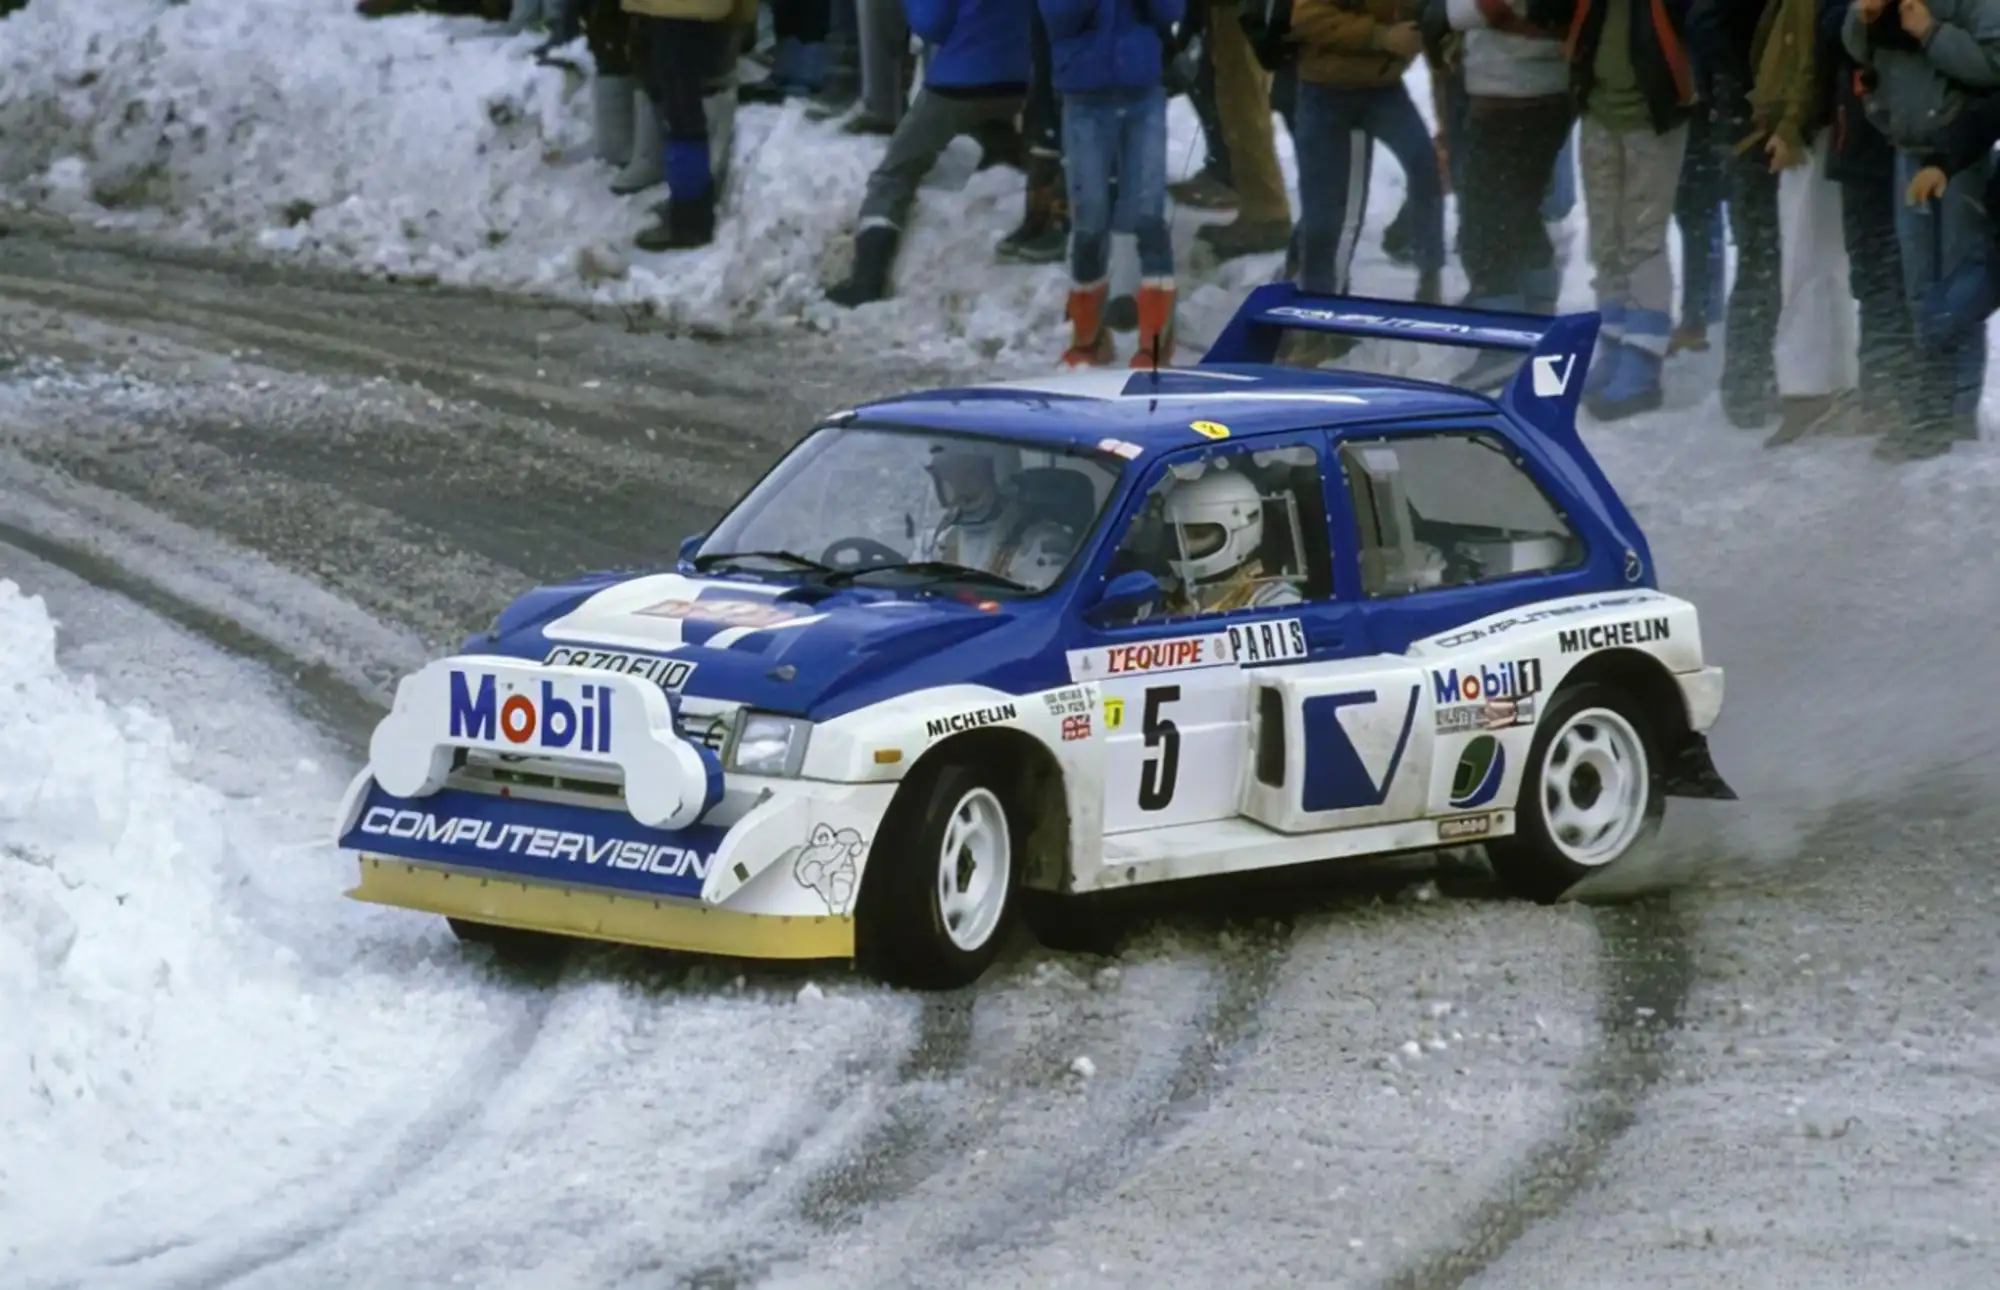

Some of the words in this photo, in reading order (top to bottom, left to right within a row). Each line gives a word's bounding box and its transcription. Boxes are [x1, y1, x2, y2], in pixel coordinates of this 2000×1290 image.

[1107, 639, 1205, 673] L'EQUIPE
[1229, 620, 1306, 661] PARIS
[1558, 617, 1671, 654] MICHELIN
[1432, 661, 1517, 704] Mobil
[449, 670, 612, 754] Mobil
[926, 703, 1018, 738] MICHELIN
[1138, 685, 1181, 811] 5
[360, 805, 716, 879] COMPUTERVISION
